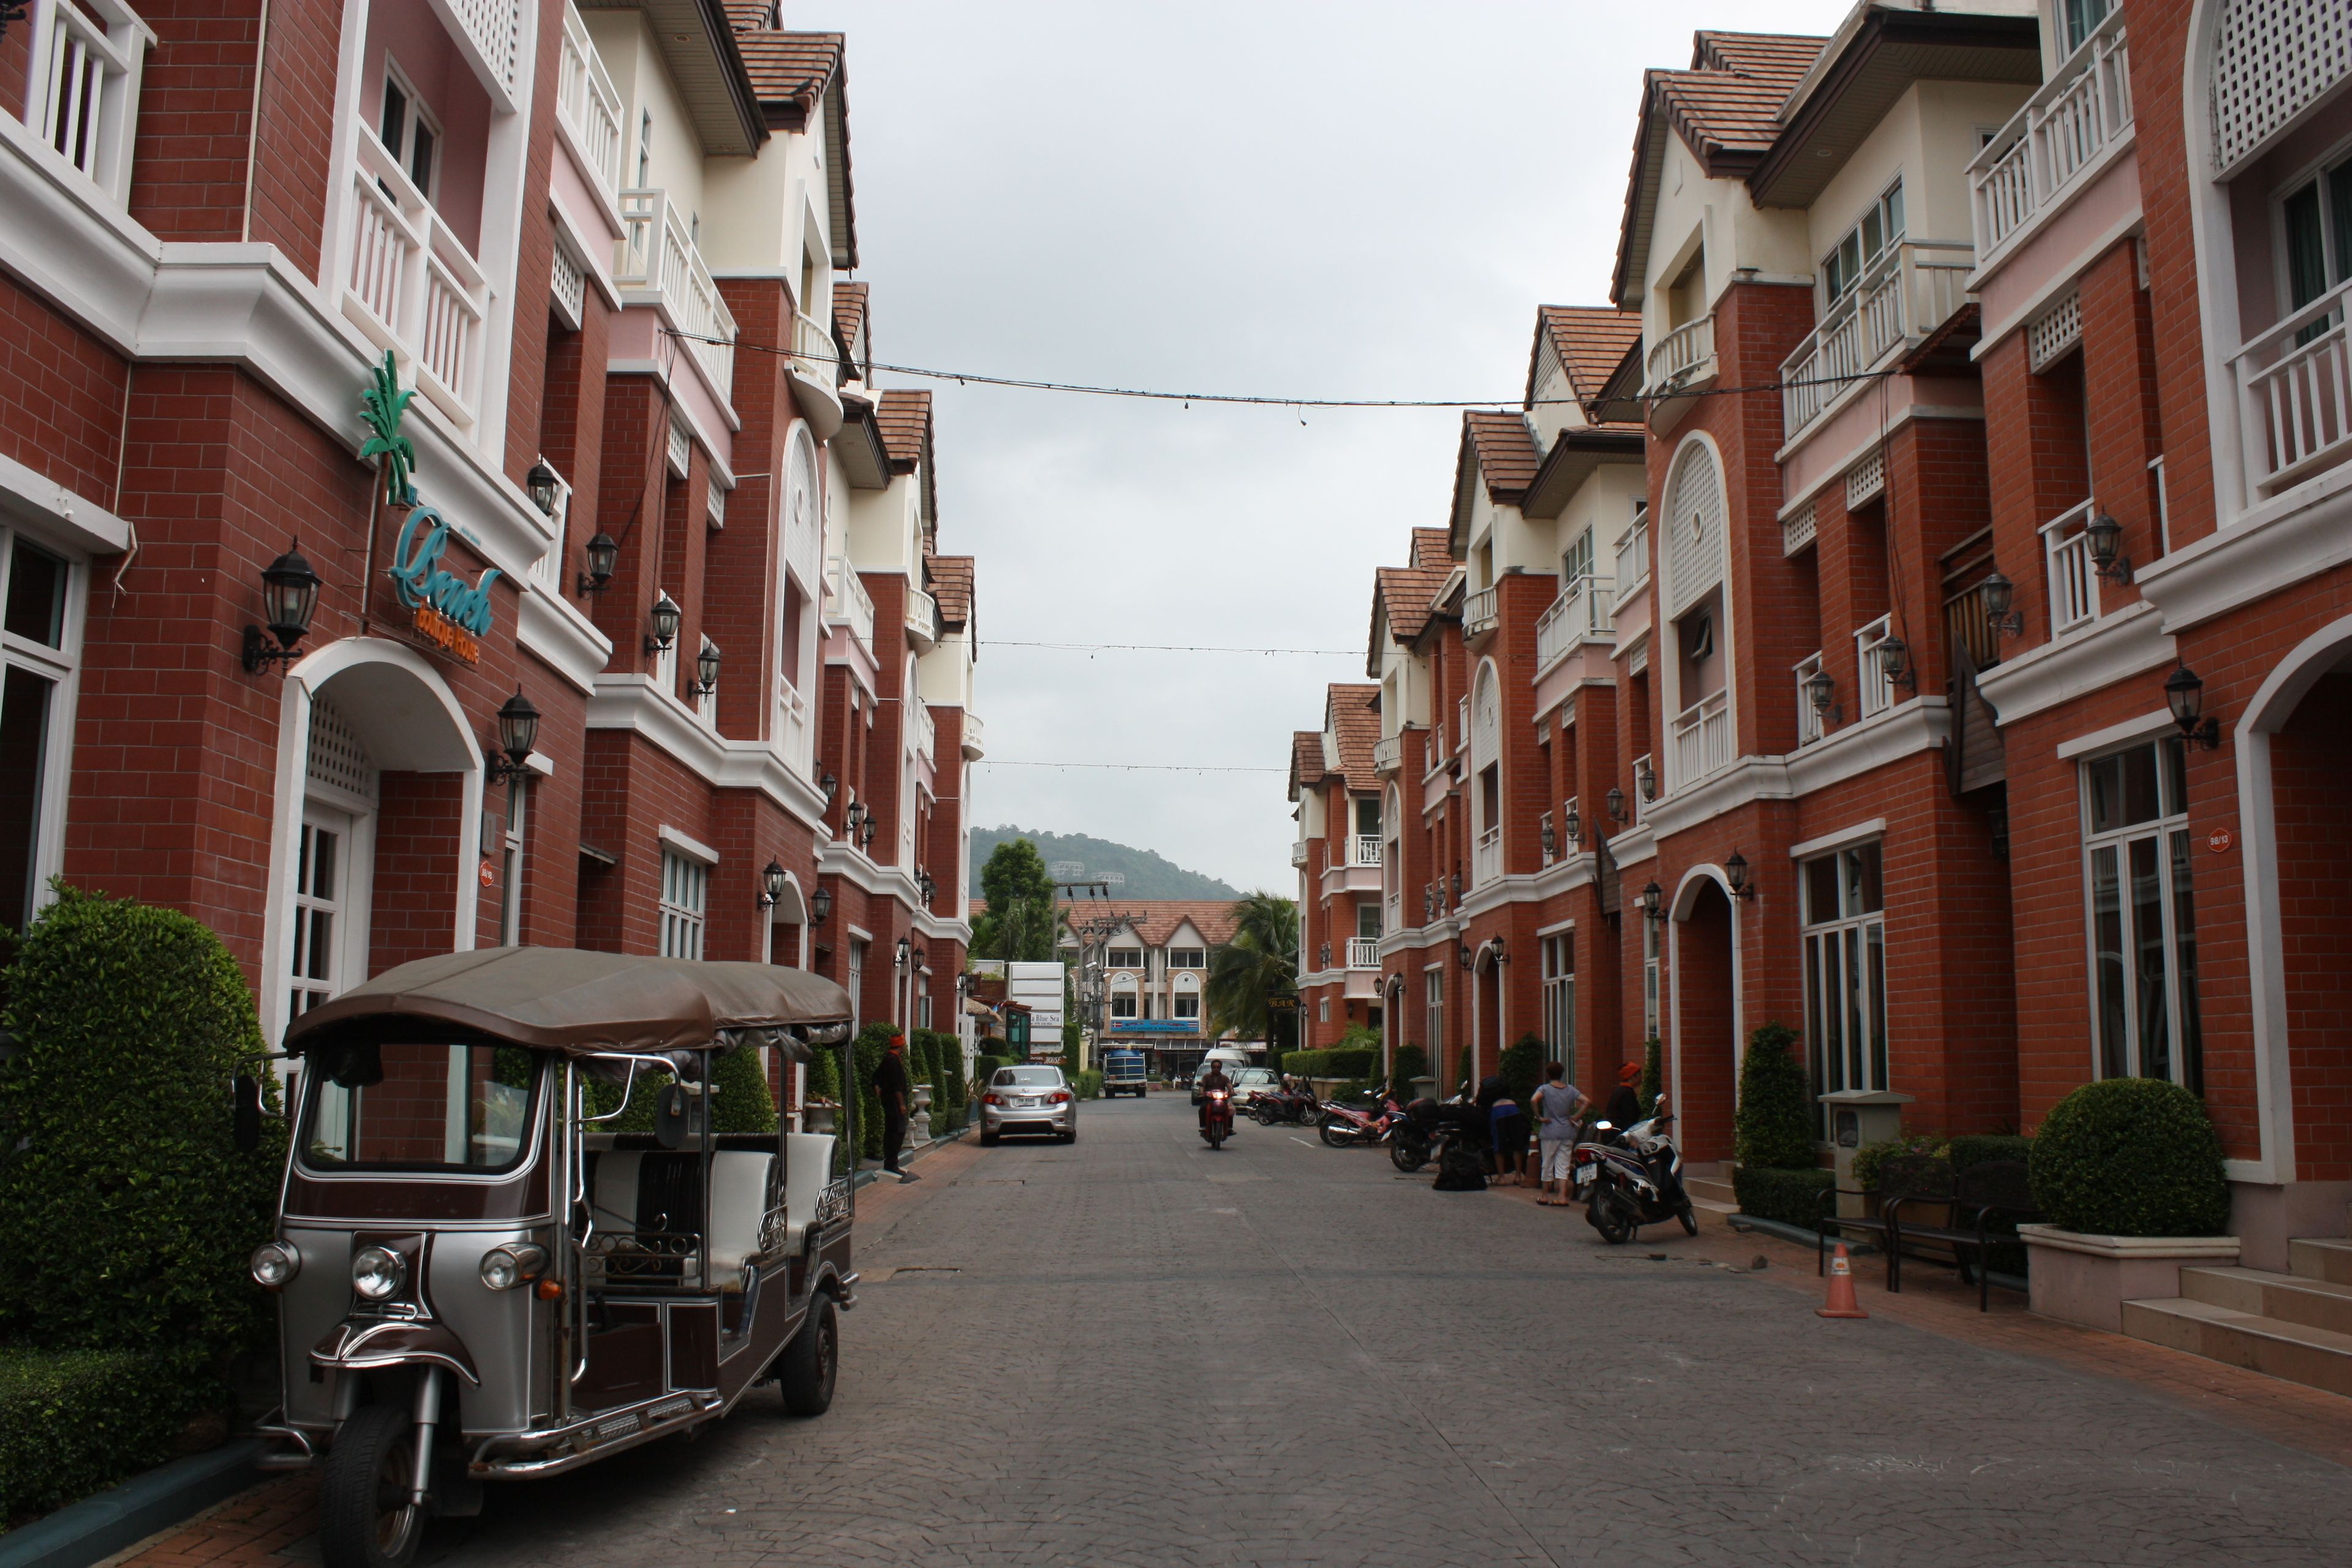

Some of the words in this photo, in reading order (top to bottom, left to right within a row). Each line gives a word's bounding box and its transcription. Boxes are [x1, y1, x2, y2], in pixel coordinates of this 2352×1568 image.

[388, 505, 502, 638] Beach
[416, 601, 453, 648] Boutique
[454, 625, 480, 665] House
[2209, 835, 2228, 845] 98/13
[1268, 999, 1295, 1008] BAR
